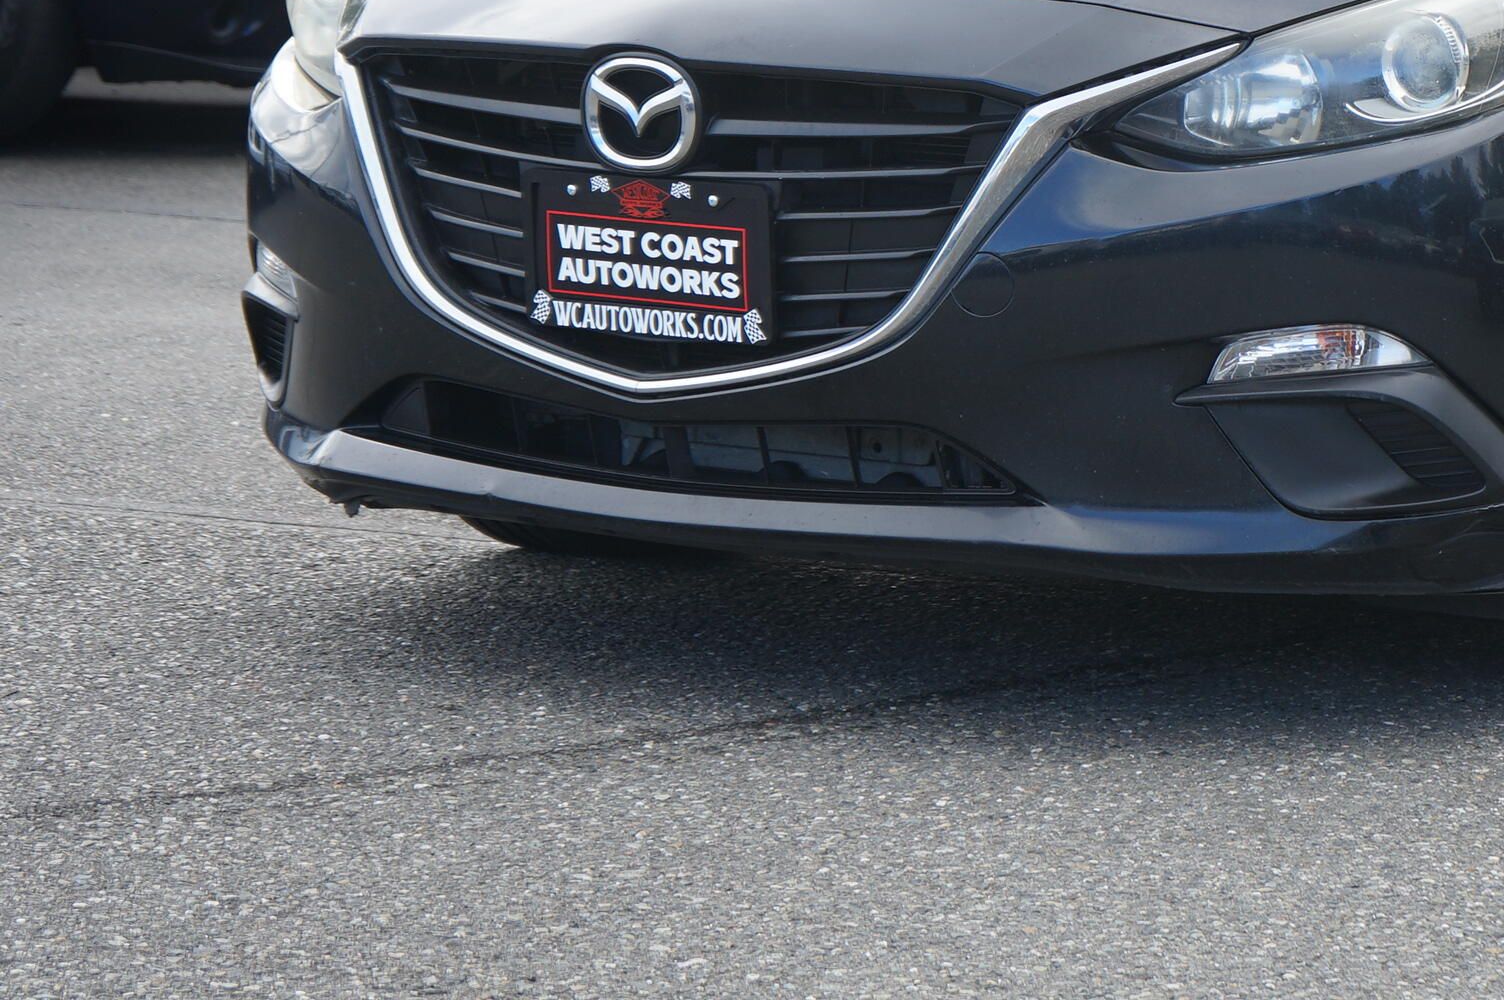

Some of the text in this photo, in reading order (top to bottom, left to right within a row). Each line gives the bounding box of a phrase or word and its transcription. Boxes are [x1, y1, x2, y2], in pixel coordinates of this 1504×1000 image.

[556, 223, 739, 265] WEST COAST
[557, 257, 741, 299] AUTOWORKS
[552, 300, 743, 343] WCAUTOWORKS.COM
